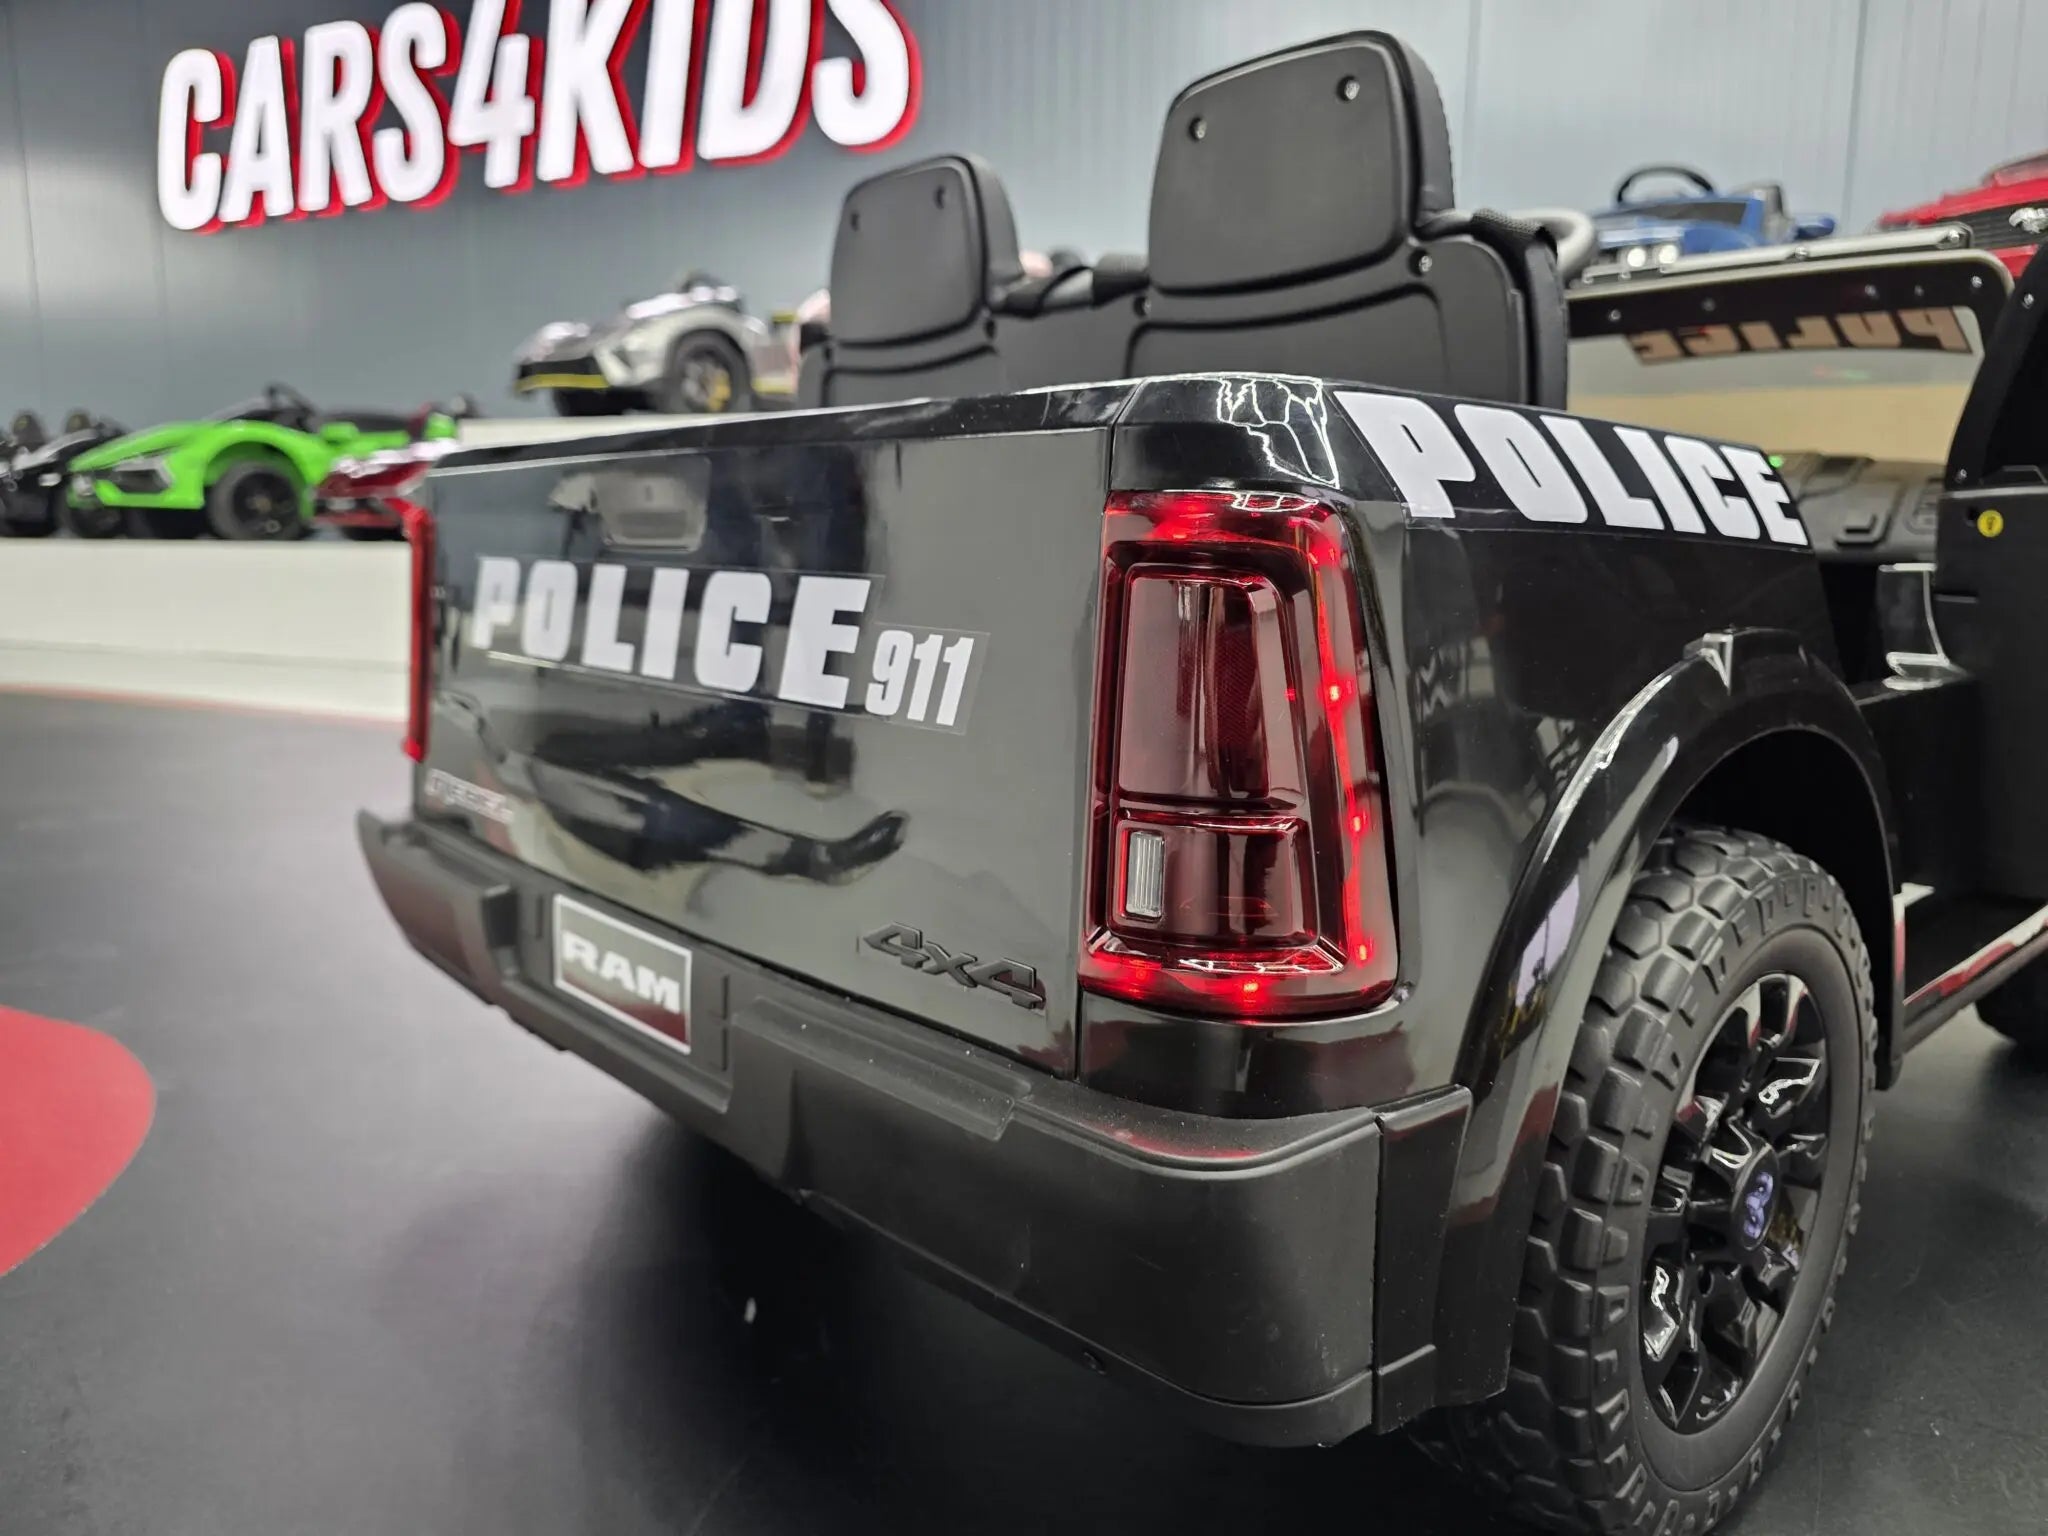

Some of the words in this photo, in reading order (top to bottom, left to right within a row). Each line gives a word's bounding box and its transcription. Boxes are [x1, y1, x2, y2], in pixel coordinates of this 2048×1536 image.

[158, 0, 919, 231] CARS4KIDS
[1334, 391, 1808, 546] POLICE
[471, 556, 872, 710] POLICE
[866, 629, 975, 727] 911
[562, 929, 681, 1014] RAM
